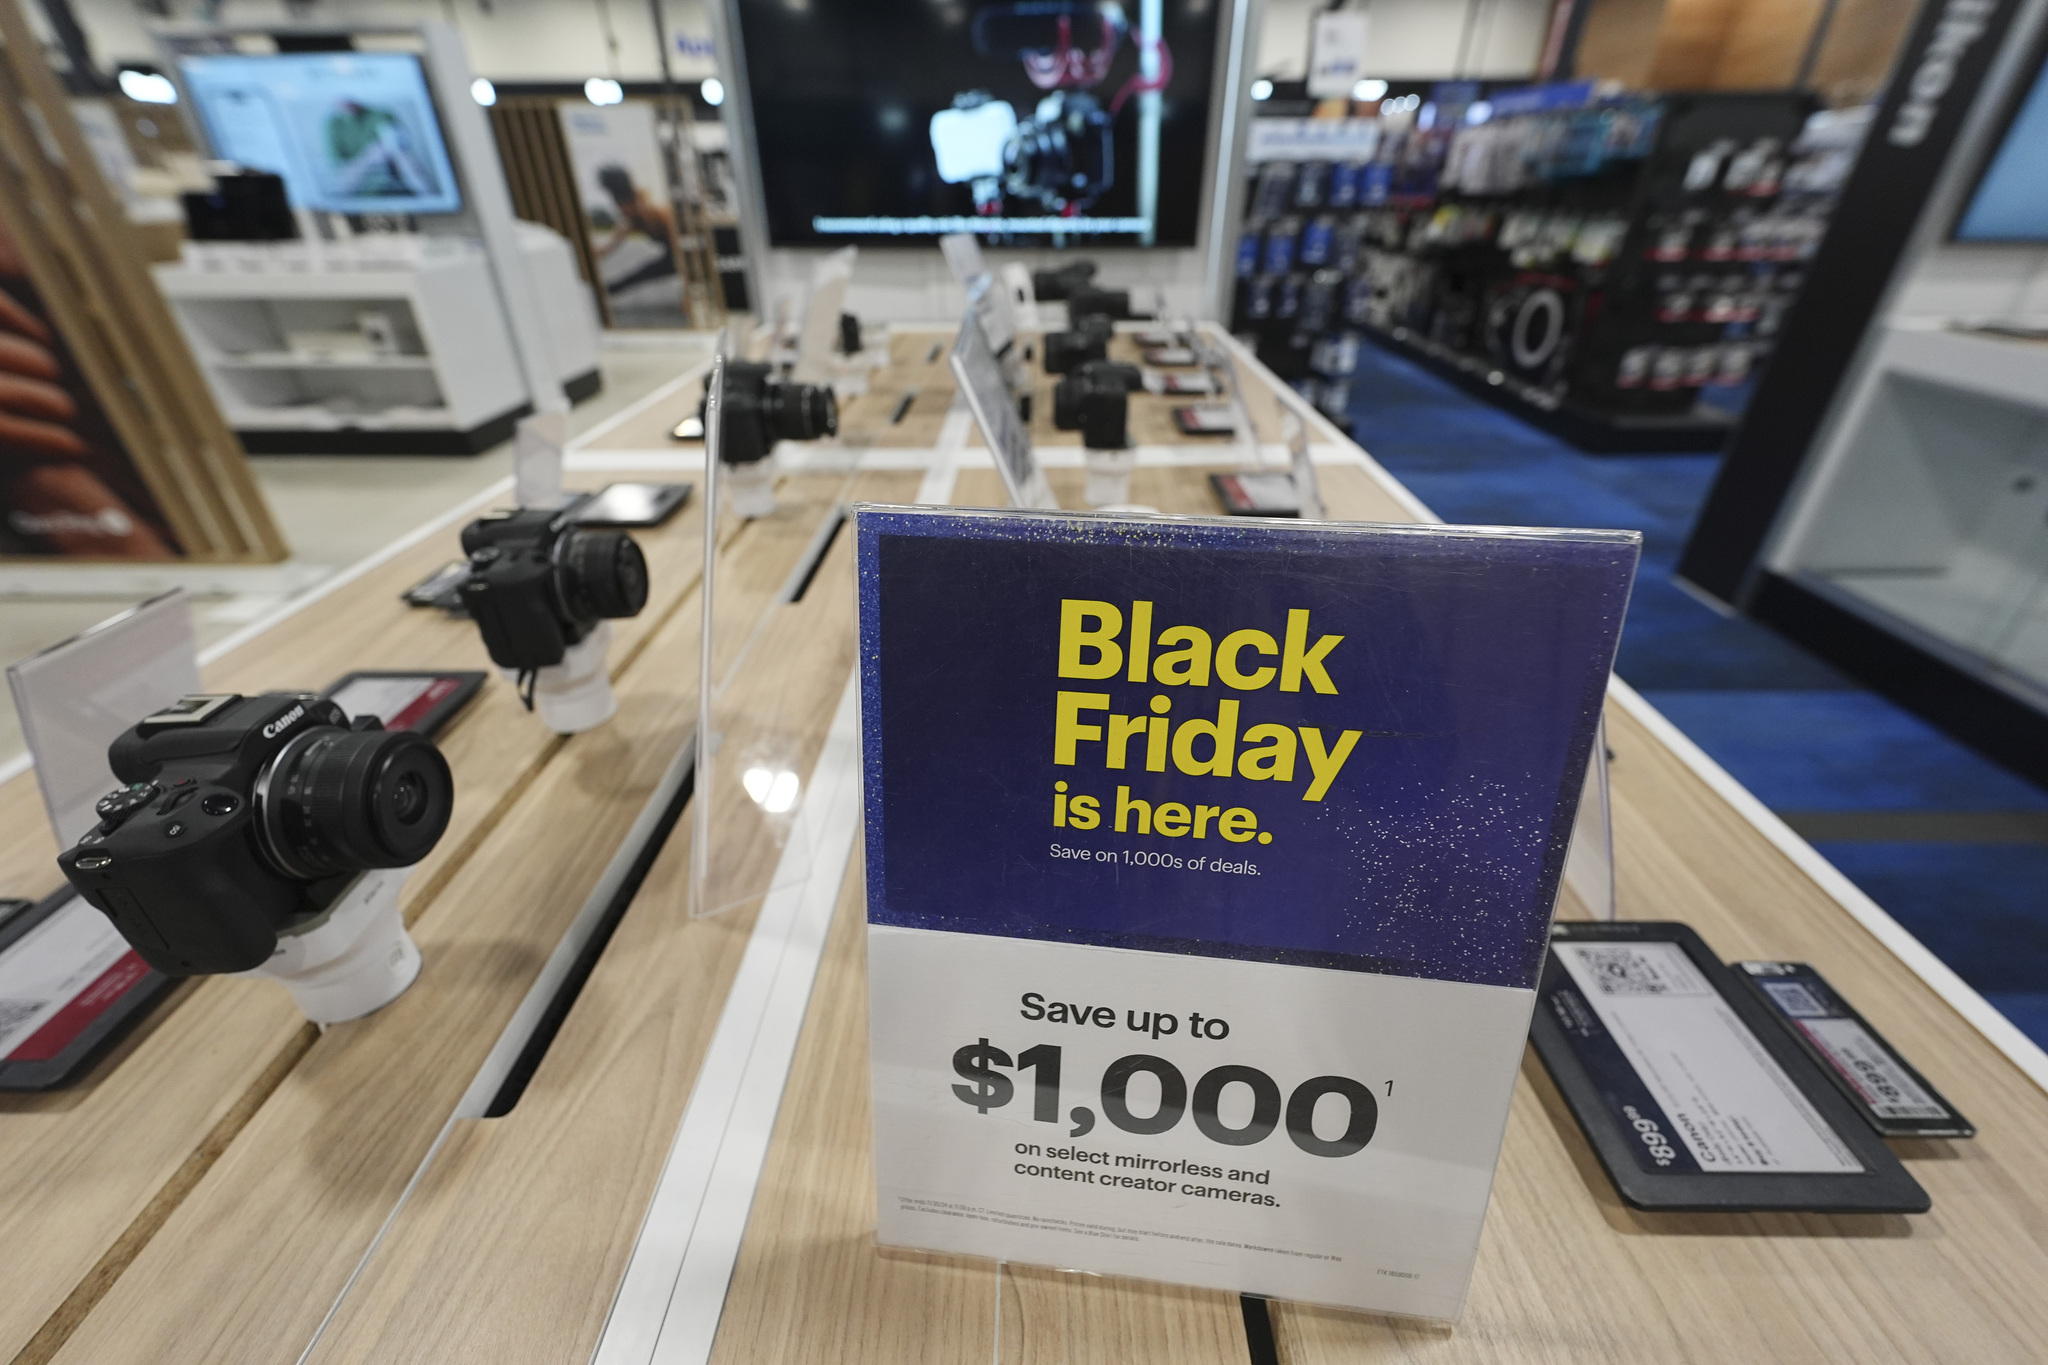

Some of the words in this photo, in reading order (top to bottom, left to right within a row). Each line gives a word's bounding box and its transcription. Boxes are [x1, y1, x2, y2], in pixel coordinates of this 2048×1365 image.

[1058, 598, 1345, 695] Black
[262, 704, 305, 739] Canon
[1054, 690, 1364, 802] Friday
[1053, 780, 1101, 830] is
[1114, 785, 1273, 845] here.
[1049, 843, 1091, 861] Save
[1095, 851, 1118, 863] on
[1122, 850, 1183, 869] 1,000s
[1187, 856, 1207, 871] of
[1209, 857, 1261, 876] deals.
[1020, 992, 1116, 1029] Save
[1126, 1009, 1180, 1040] up
[1188, 1012, 1231, 1041] to
[951, 1037, 1379, 1158] $1,000
[1676, 1113, 1717, 1163] Canon
[1014, 1143, 1042, 1157] on
[1046, 1145, 1110, 1166] select
[1115, 1153, 1223, 1179] mirrorless
[1227, 1169, 1270, 1185] and
[1014, 1163, 1095, 1184] content
[1099, 1174, 1177, 1193] creator
[1181, 1184, 1282, 1208] cameras.
